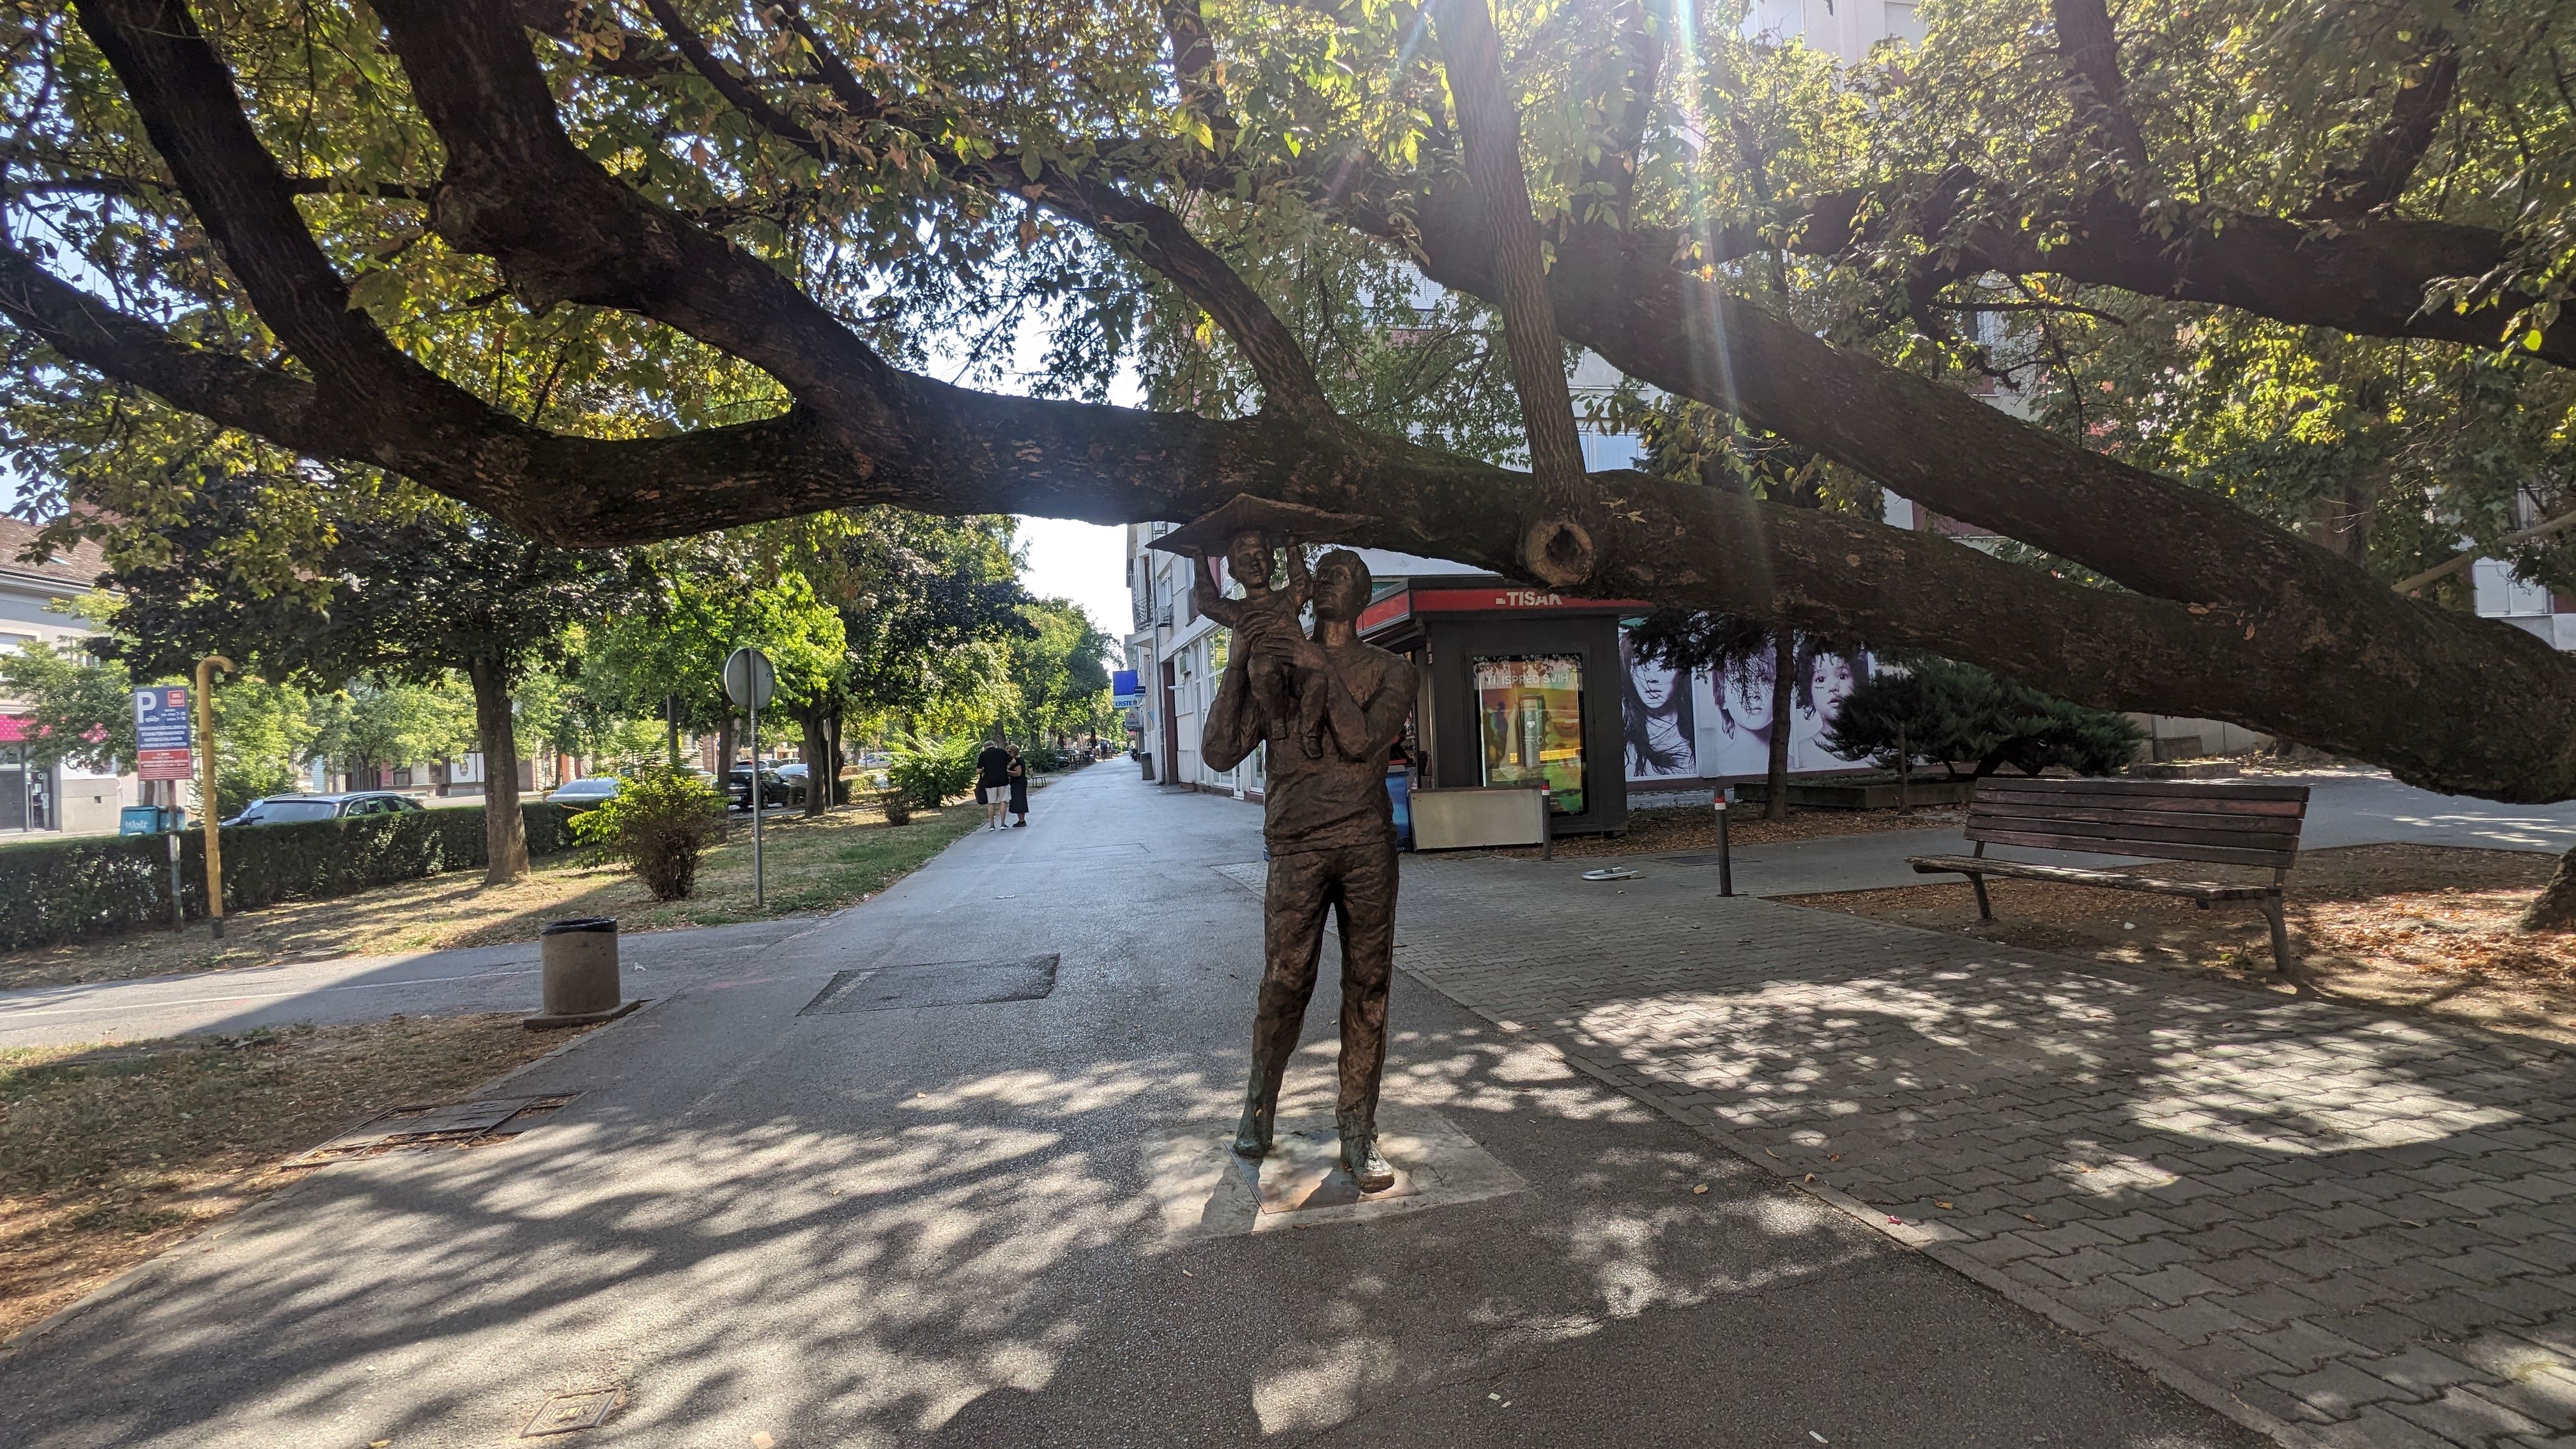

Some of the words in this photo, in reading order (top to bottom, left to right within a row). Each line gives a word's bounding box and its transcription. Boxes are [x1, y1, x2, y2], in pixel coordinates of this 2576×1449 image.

[1506, 591, 1563, 606] TISAK
[1502, 675, 1540, 685] ISPRED
[137, 691, 157, 723] P
[125, 820, 149, 829] Wolt
